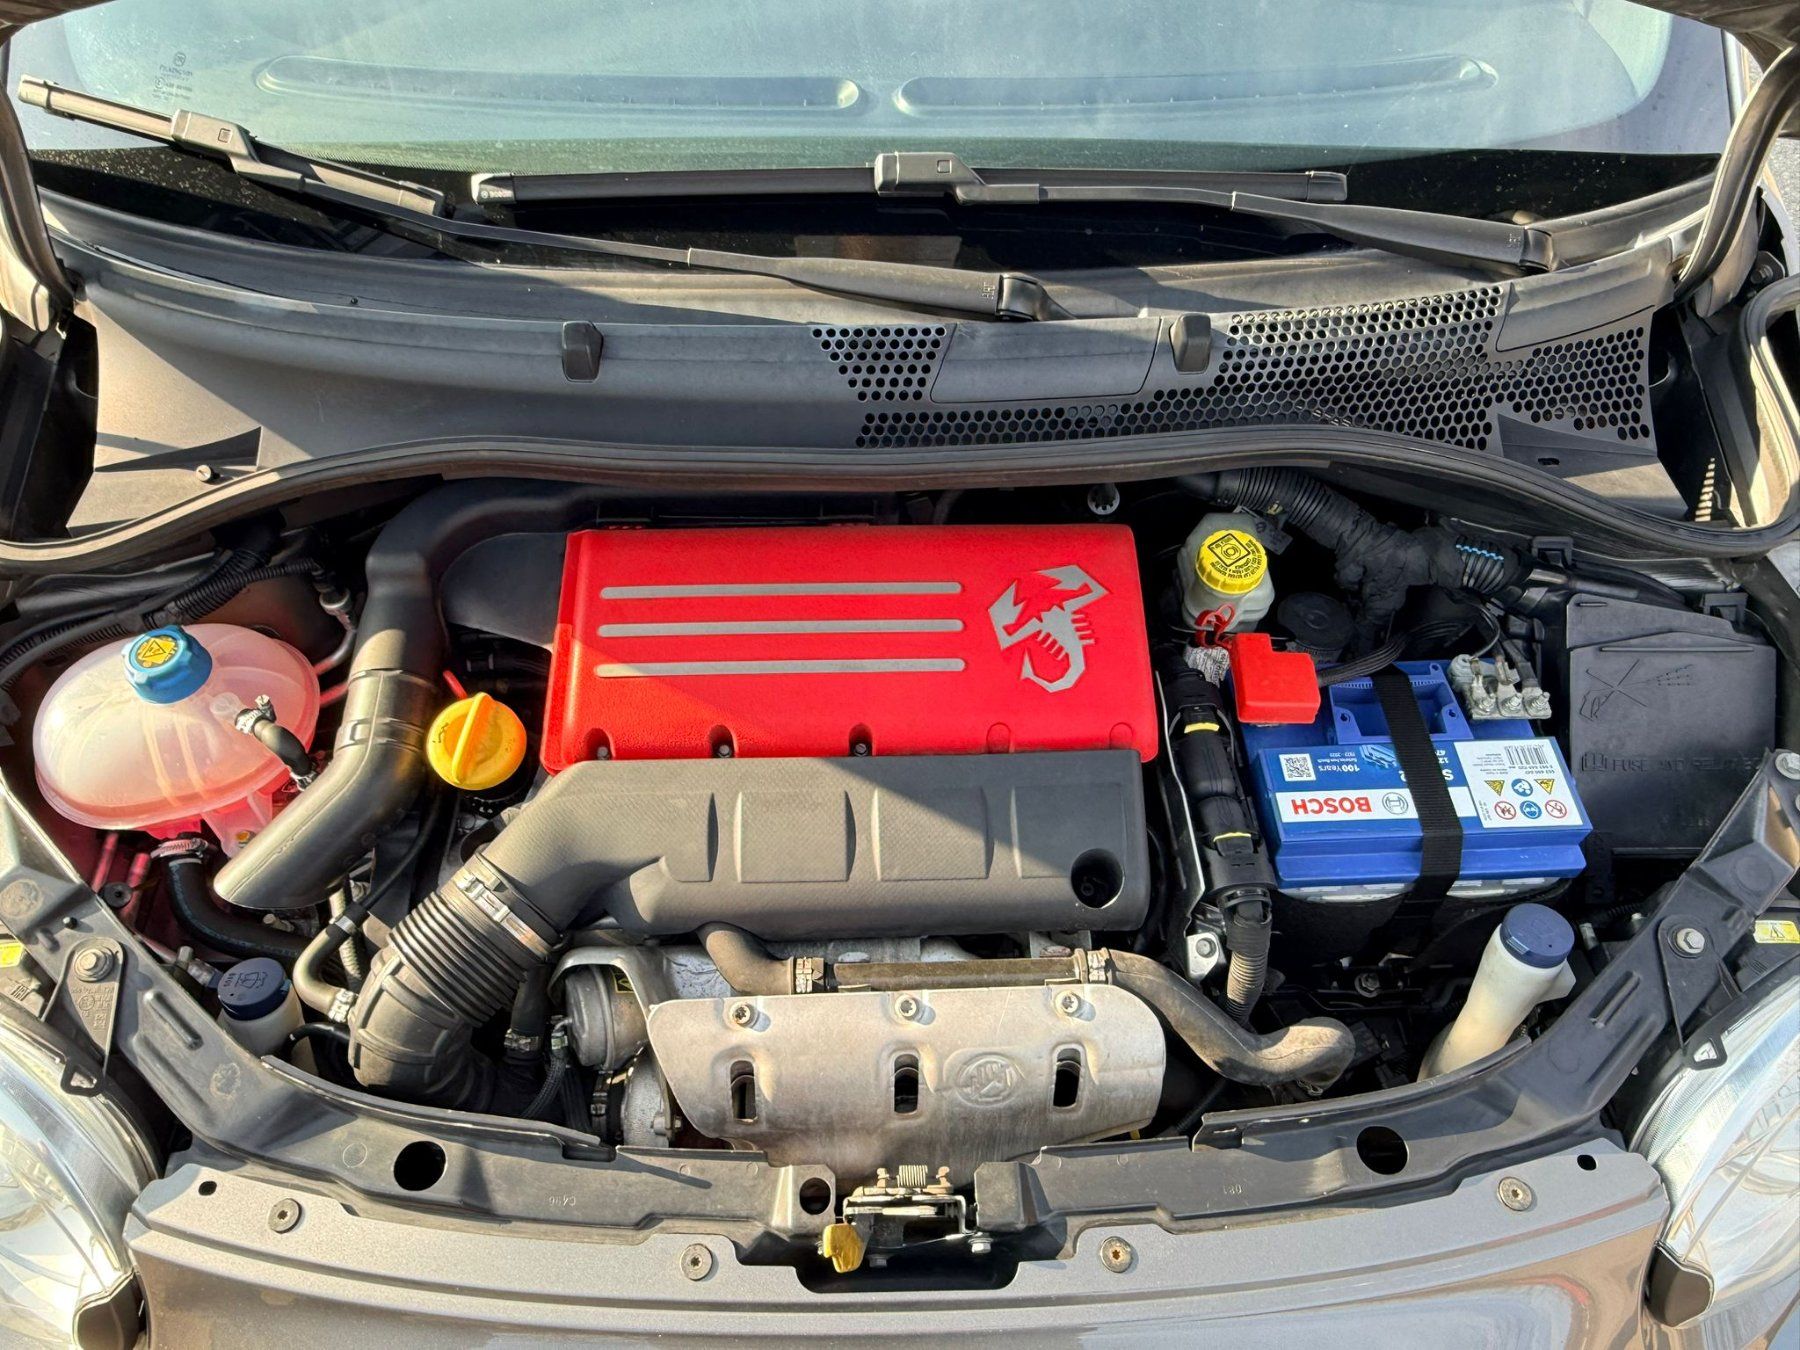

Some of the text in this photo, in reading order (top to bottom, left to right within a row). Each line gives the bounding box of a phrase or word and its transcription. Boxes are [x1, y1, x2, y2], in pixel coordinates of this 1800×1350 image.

[1318, 764, 1360, 772] 100 Years
[1291, 796, 1372, 815] BOSCH
